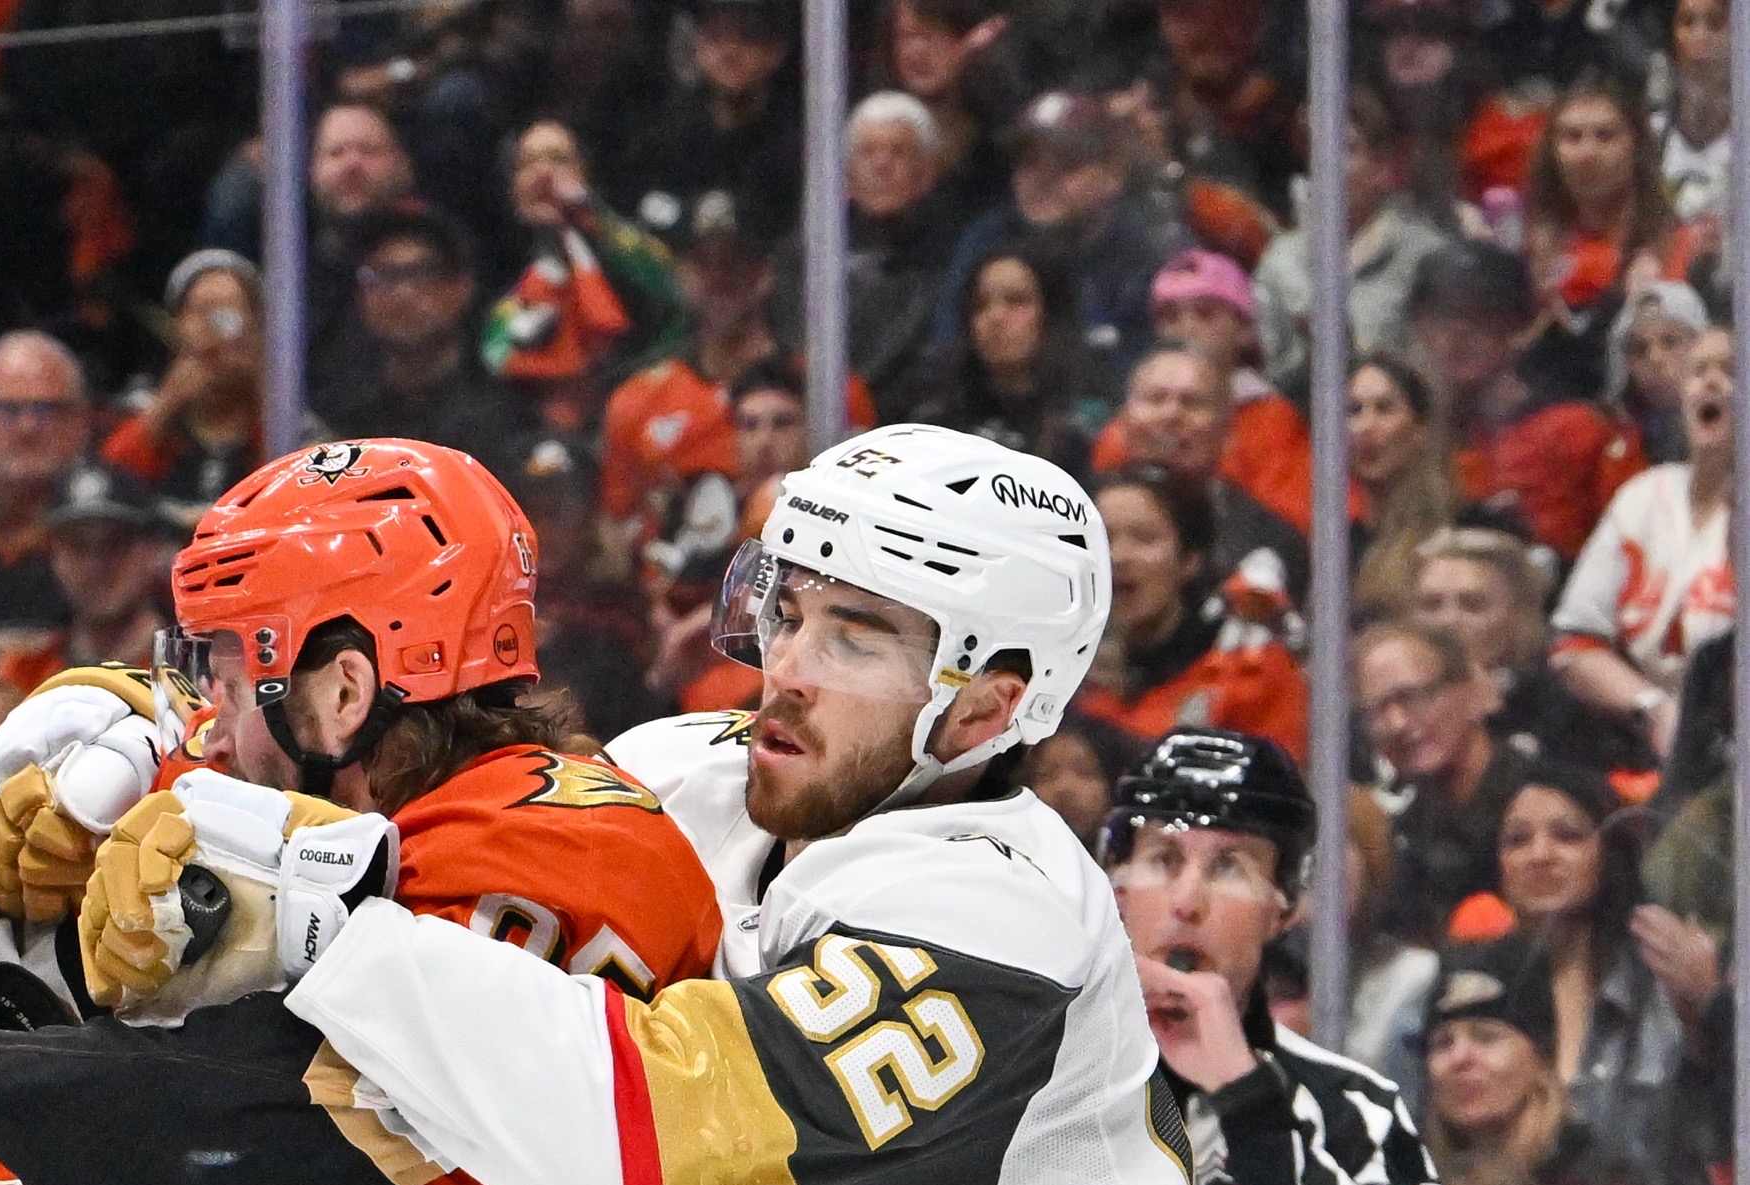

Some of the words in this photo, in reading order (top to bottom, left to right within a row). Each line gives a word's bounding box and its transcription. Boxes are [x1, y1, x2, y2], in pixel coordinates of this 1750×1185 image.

[787, 496, 850, 525] BAUER
[1018, 486, 1088, 526] NAQVI
[299, 848, 355, 867] COGHLAN
[304, 911, 322, 963] MACH
[766, 933, 986, 1151] 52
